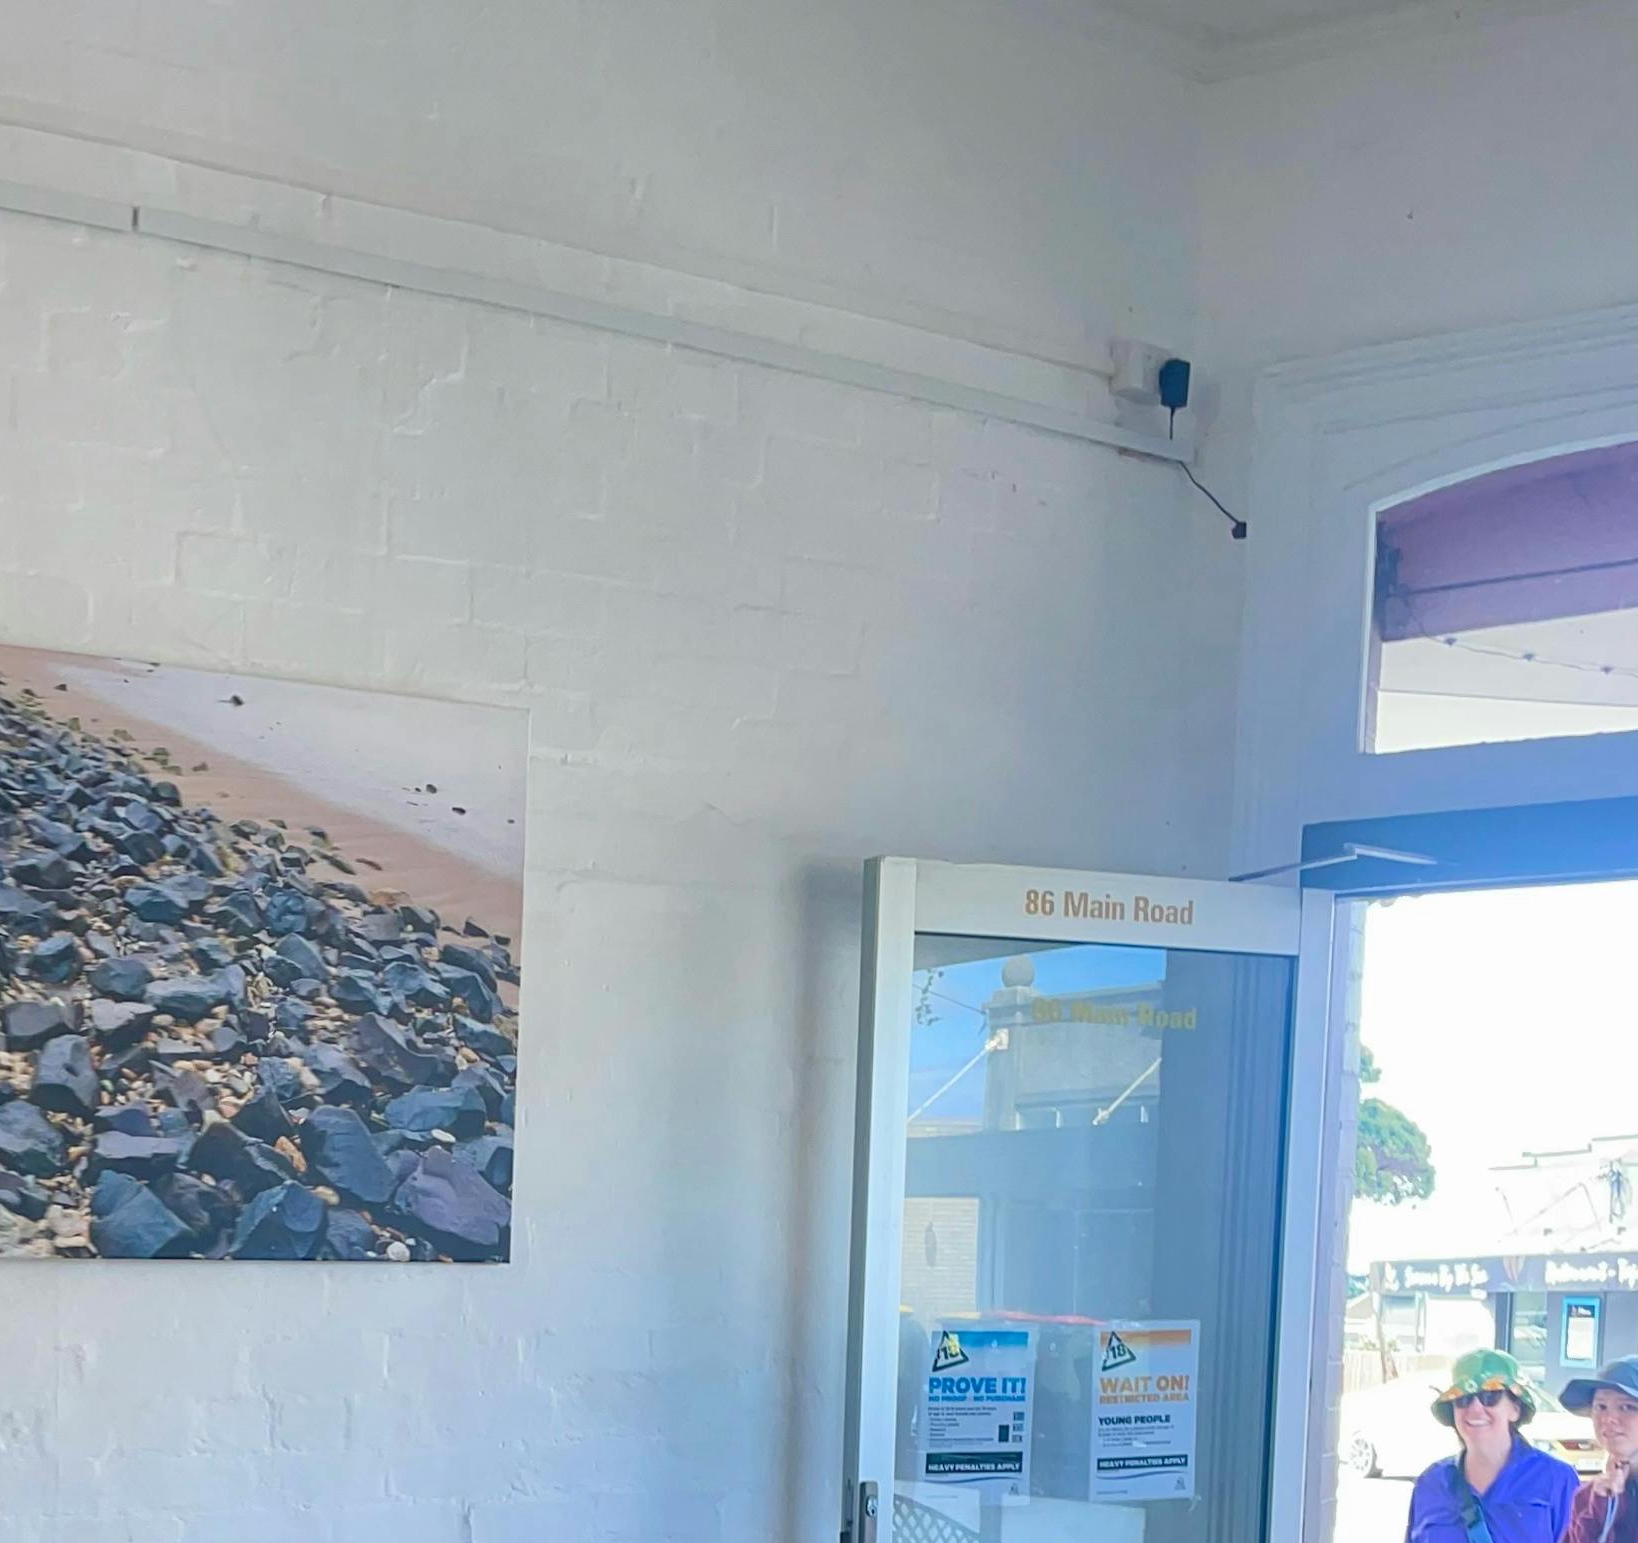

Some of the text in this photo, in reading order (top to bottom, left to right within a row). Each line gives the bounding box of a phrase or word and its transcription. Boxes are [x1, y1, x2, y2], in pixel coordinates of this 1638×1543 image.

[1025, 889, 1194, 926] 86 Main Road
[1109, 1342, 1127, 1360] 18
[928, 1377, 1026, 1394] PROVE IT!
[1099, 1374, 1190, 1394] WAIT ON!
[1098, 1414, 1171, 1426] YOUNG PEOPLE
[928, 1463, 1020, 1471] HEAVY PENALTIES APPLY
